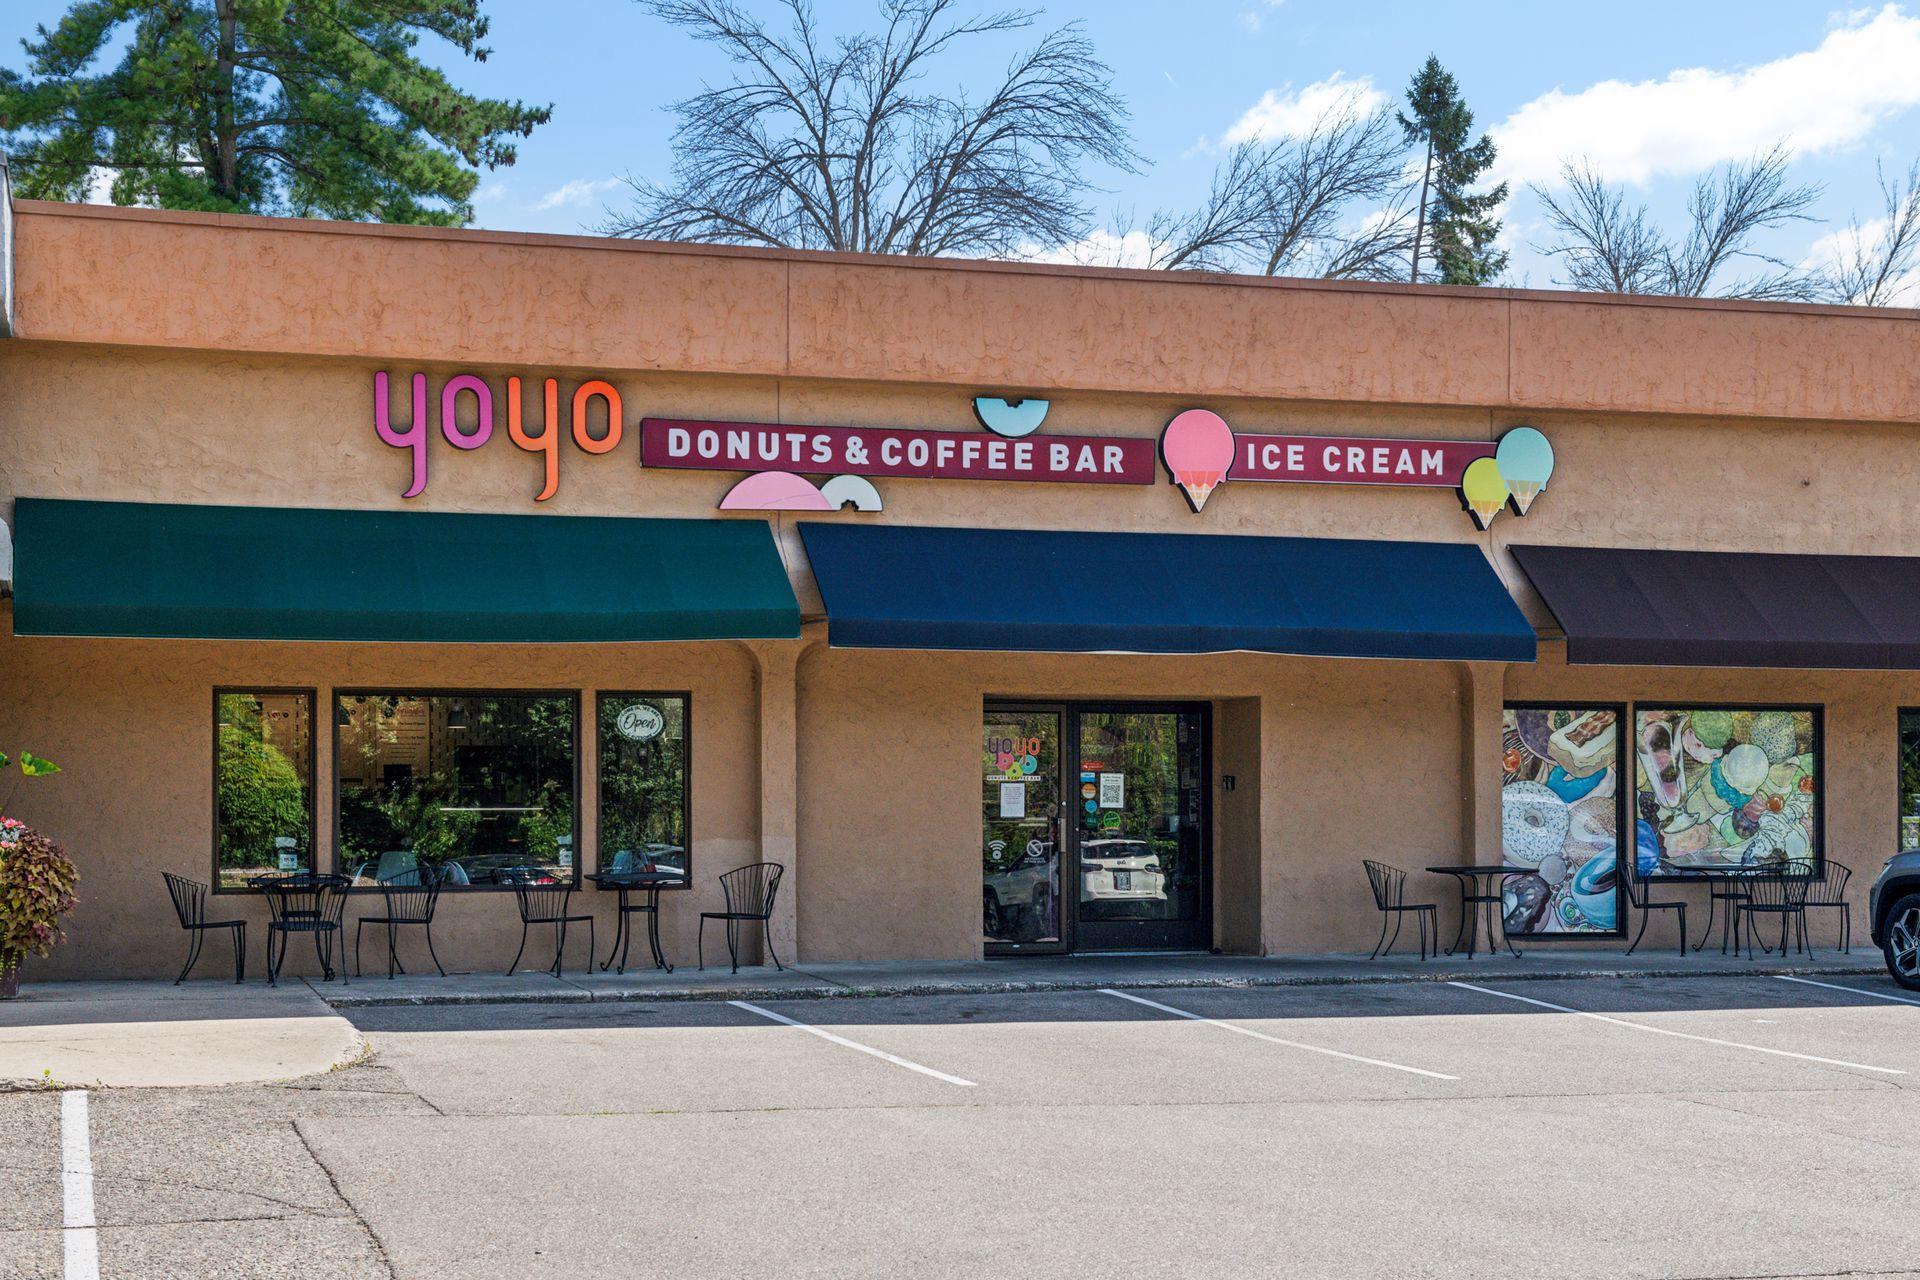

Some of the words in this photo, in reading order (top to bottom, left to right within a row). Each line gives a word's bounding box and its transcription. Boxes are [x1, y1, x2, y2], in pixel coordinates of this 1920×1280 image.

[374, 370, 623, 502] yoyo
[668, 428, 833, 464] DONUTS
[845, 436, 870, 465] &
[881, 437, 1034, 471] COFFEE
[1050, 443, 1125, 474] BAR
[1247, 443, 1305, 471] ICE
[1322, 445, 1444, 476] CREAM
[623, 713, 656, 732] Open
[988, 736, 1041, 765] yoyo
